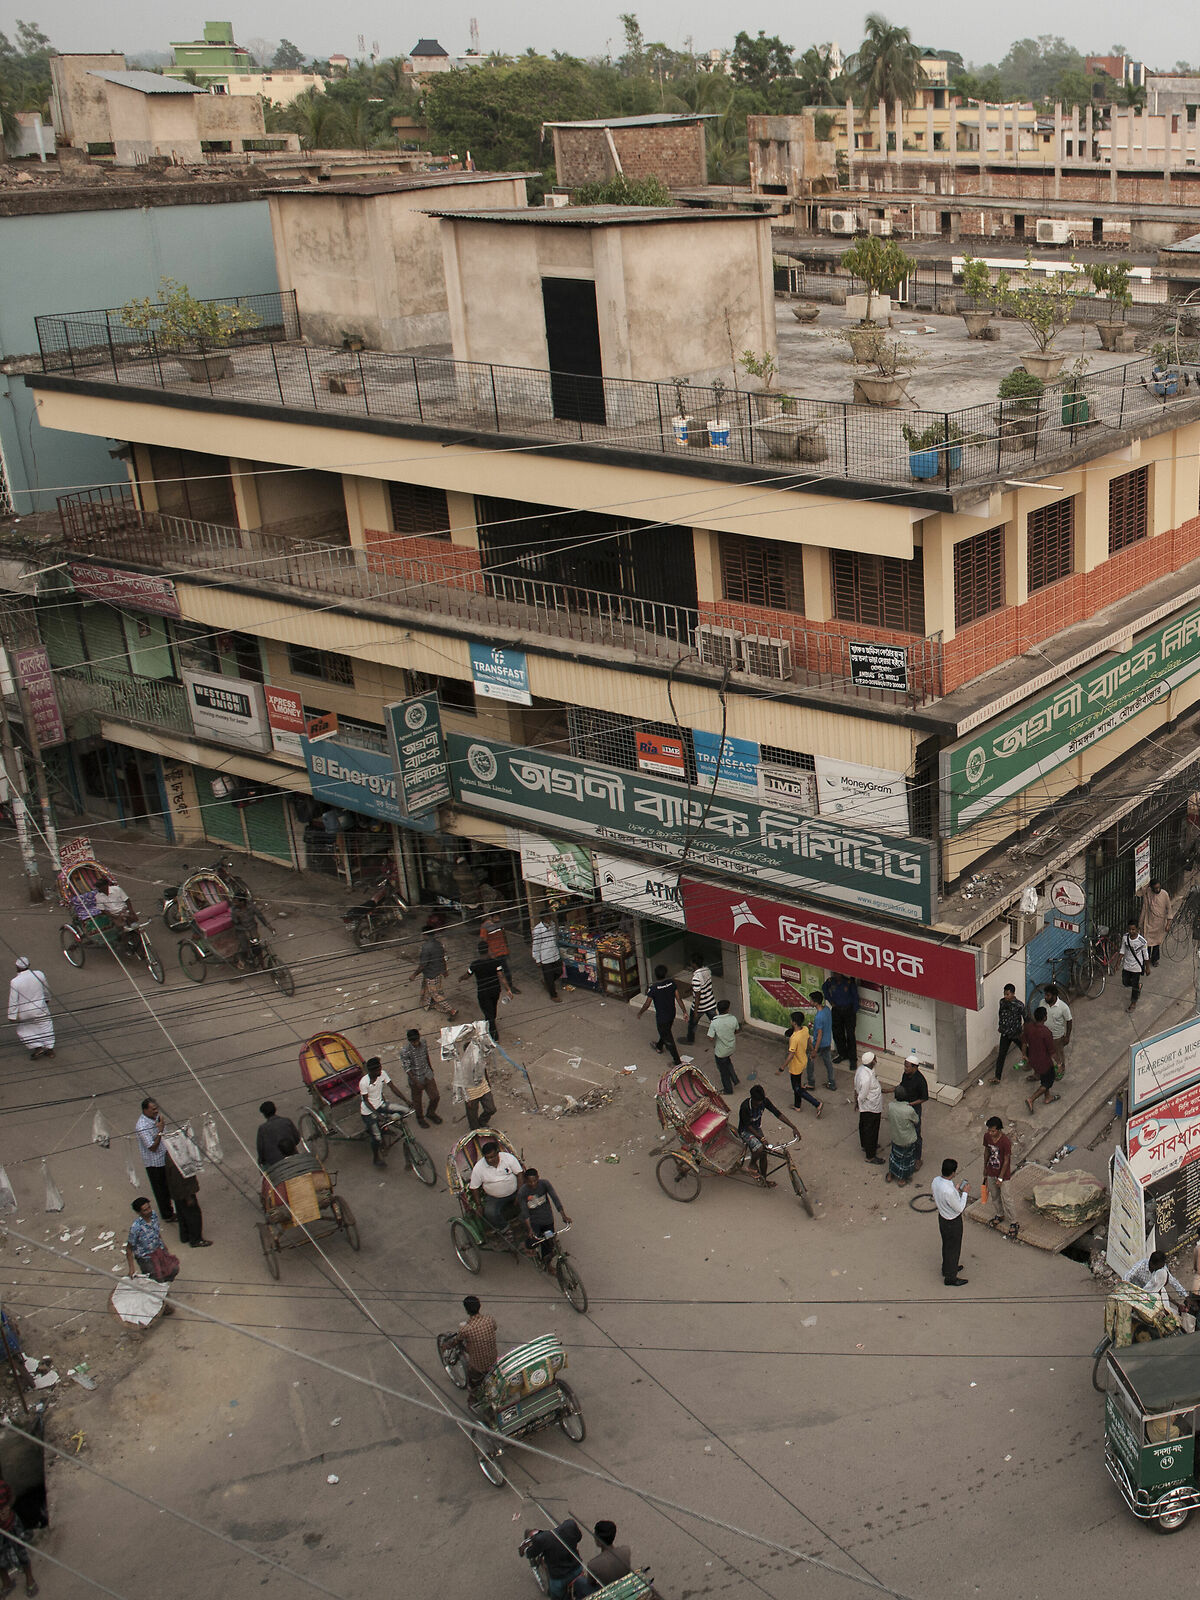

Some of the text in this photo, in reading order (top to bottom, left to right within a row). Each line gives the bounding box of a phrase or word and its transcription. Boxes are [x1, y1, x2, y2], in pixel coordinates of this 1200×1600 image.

[473, 660, 525, 681] TRANSFAST
[195, 685, 240, 704] WESTERN
[210, 697, 241, 712] UNION
[268, 695, 297, 709] XPRESS
[993, 642, 1157, 758] অগ্রণী ব্যাংক
[276, 705, 301, 718] MONEY
[1068, 684, 1162, 754] শ্রীমঙ্গল শাখা, মৌলভীবাজার
[310, 719, 330, 735] Ria
[402, 731, 439, 755] অগ্রণী
[640, 740, 681, 756] Ria IME
[405, 746, 441, 769] ব্যাংক
[697, 752, 759, 774] TRANSFAST
[404, 763, 447, 788] লিমিটেড
[460, 777, 513, 795] Agrani Bank Limited
[769, 778, 800, 794] IME
[840, 776, 892, 795] MoneyGram
[509, 757, 625, 813] অগ্রণী
[634, 787, 749, 837] ব্যাংক
[757, 809, 921, 885] লিমিটেড
[646, 879, 678, 903] ATM
[856, 894, 919, 917] www.agranibank.org
[1060, 921, 1073, 931] ATM
[778, 915, 925, 979] সিটি ব্যাংক
[1137, 1064, 1150, 1077] TEA
[1152, 1050, 1178, 1071] RESORT
[1151, 1477, 1187, 1491] POWER
